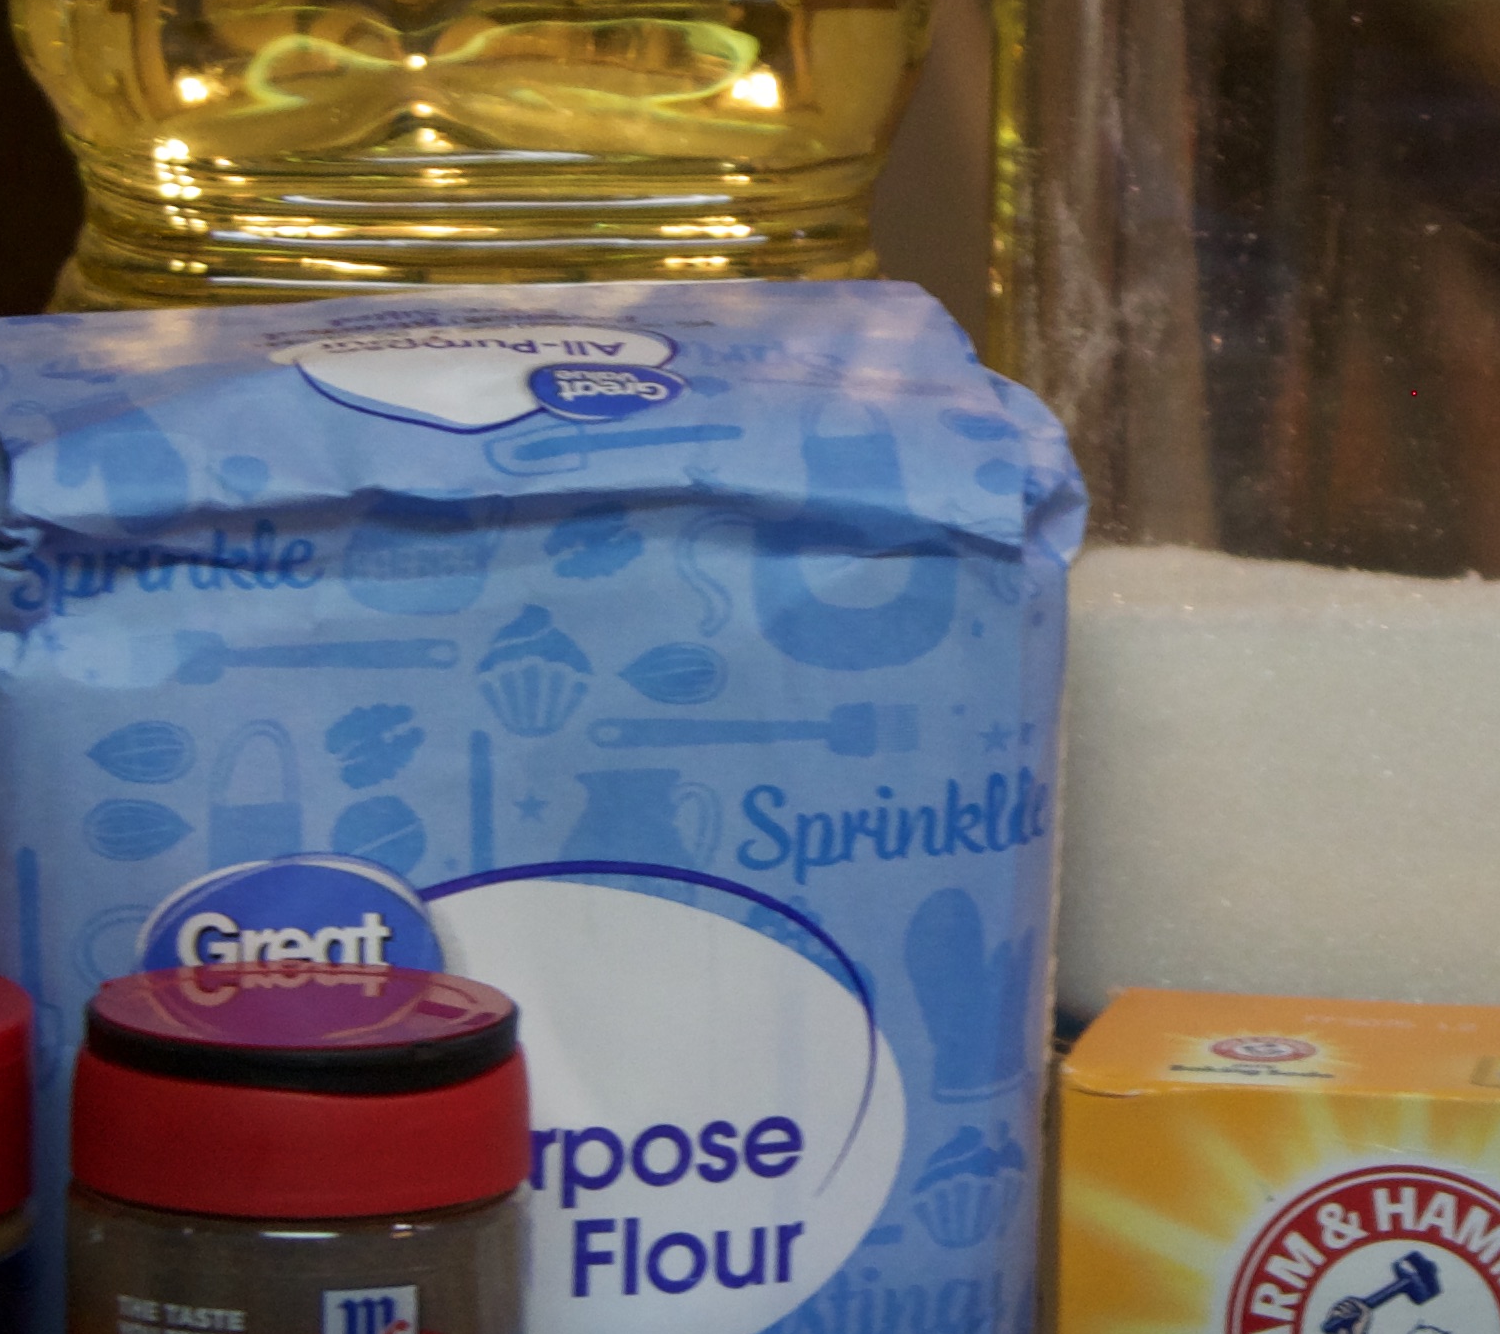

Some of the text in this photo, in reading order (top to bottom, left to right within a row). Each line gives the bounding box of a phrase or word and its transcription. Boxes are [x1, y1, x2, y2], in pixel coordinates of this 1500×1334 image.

[556, 378, 668, 403] Great
[176, 910, 393, 972] Great
[528, 1113, 805, 1208] rpose
[1319, 1200, 1370, 1251] &
[571, 1210, 807, 1298] Flour
[164, 1301, 245, 1332] TASTE
